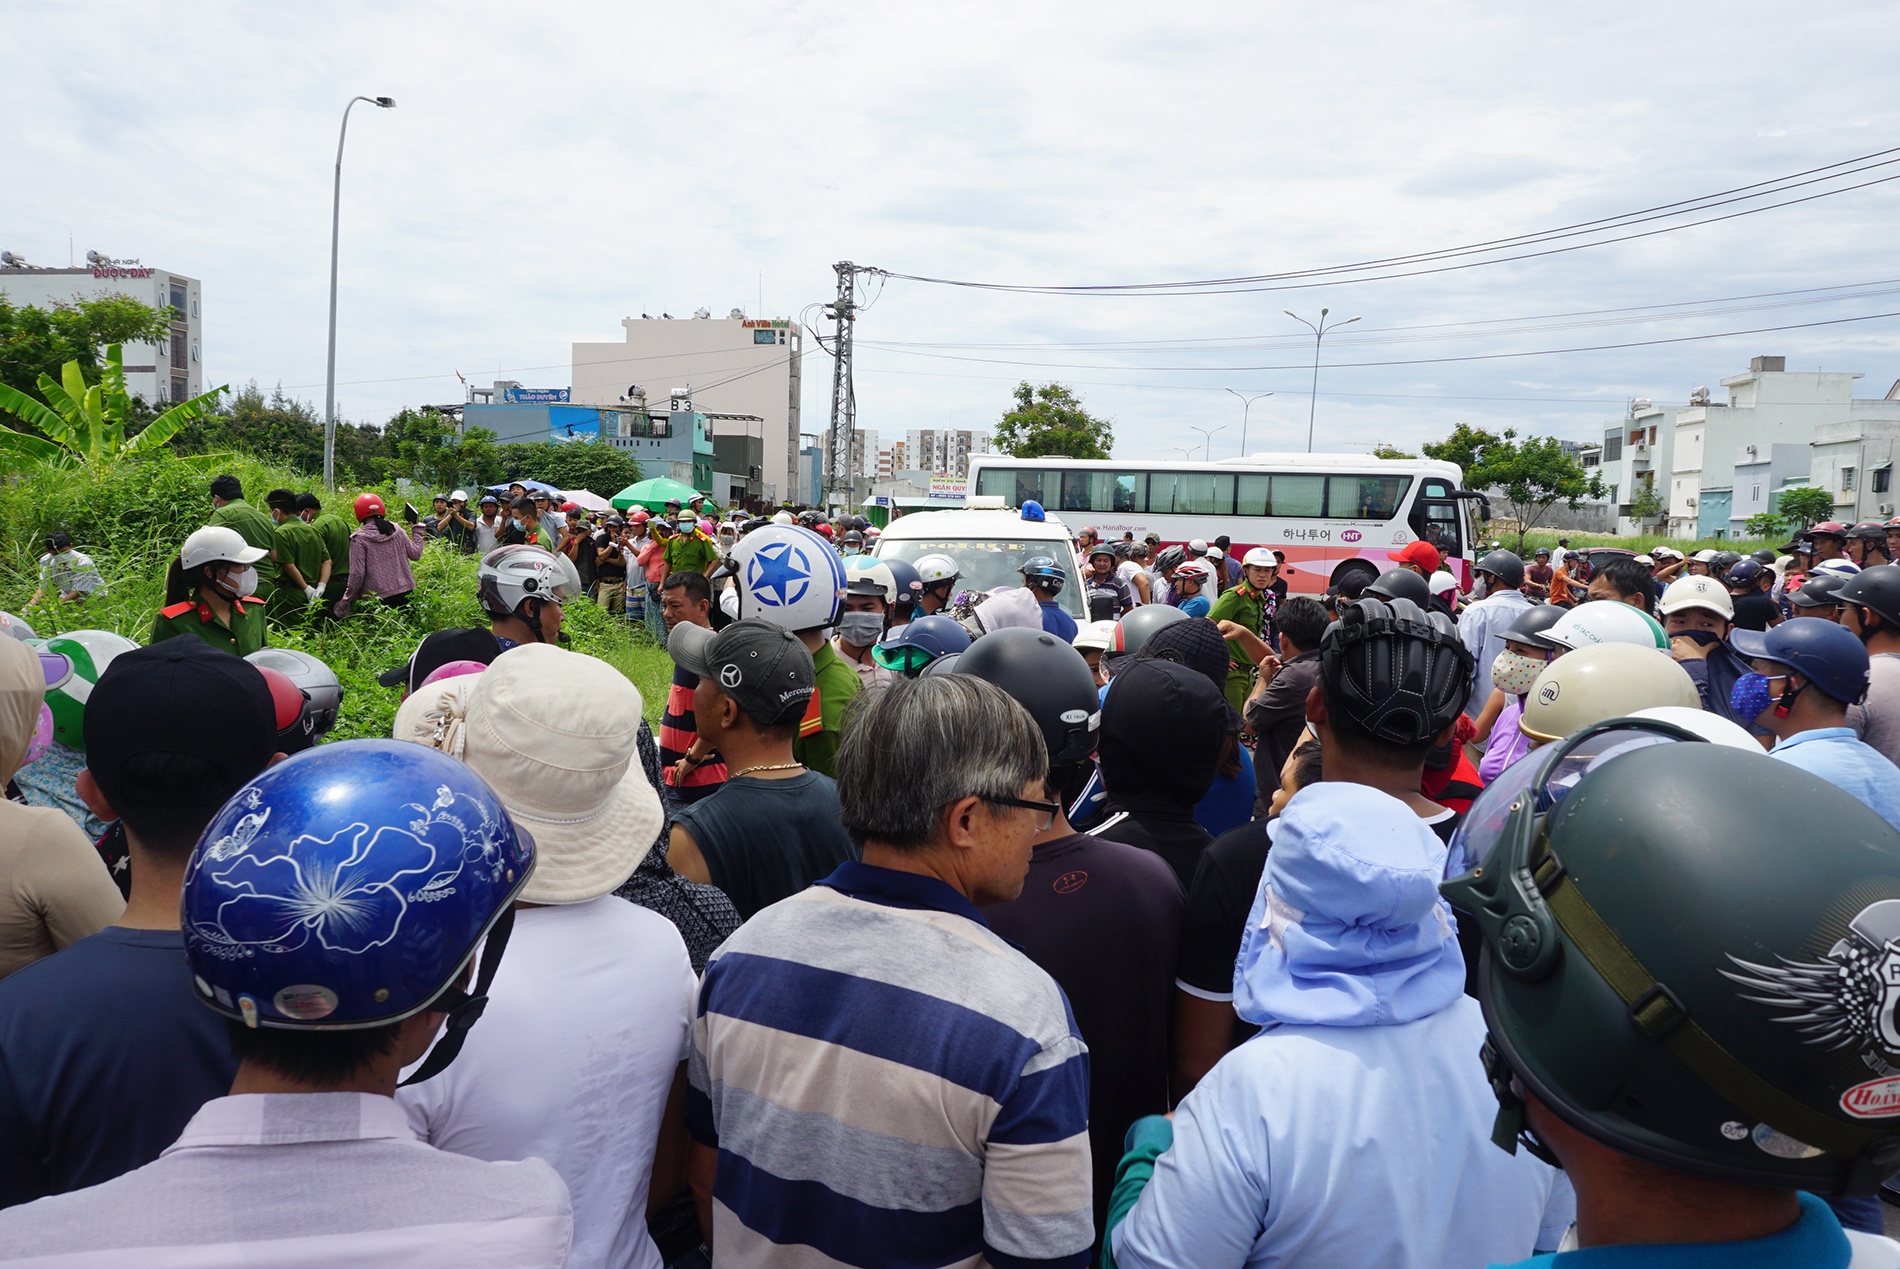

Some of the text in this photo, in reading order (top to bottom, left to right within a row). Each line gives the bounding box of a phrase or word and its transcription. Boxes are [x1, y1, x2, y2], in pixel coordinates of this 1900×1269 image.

[742, 319, 790, 328] Anh Villa Hotel
[1282, 528, 1332, 542] 하나투어
[1342, 532, 1361, 541] HNT
[919, 542, 1026, 550] POLICE
